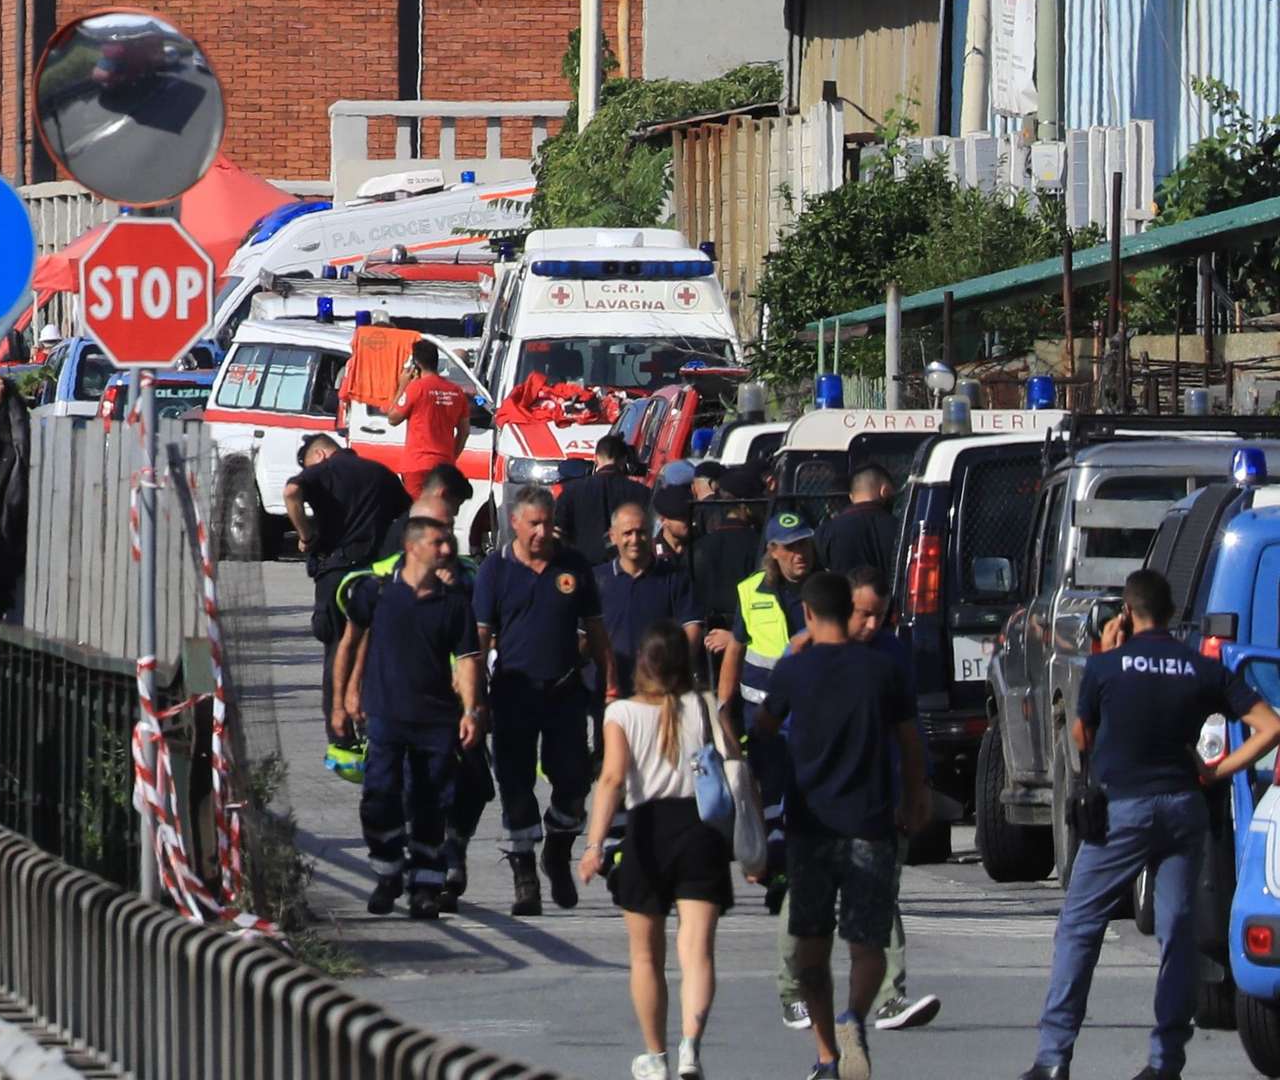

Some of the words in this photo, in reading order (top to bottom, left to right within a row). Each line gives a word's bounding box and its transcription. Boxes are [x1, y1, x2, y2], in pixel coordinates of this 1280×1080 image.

[369, 219, 430, 241] CROCE
[89, 265, 203, 320] STOP
[601, 283, 644, 293] C.R.I.
[585, 299, 665, 310] LAVAGNA
[843, 414, 1037, 429] CARABIERI
[1122, 655, 1196, 676] POLIZIA
